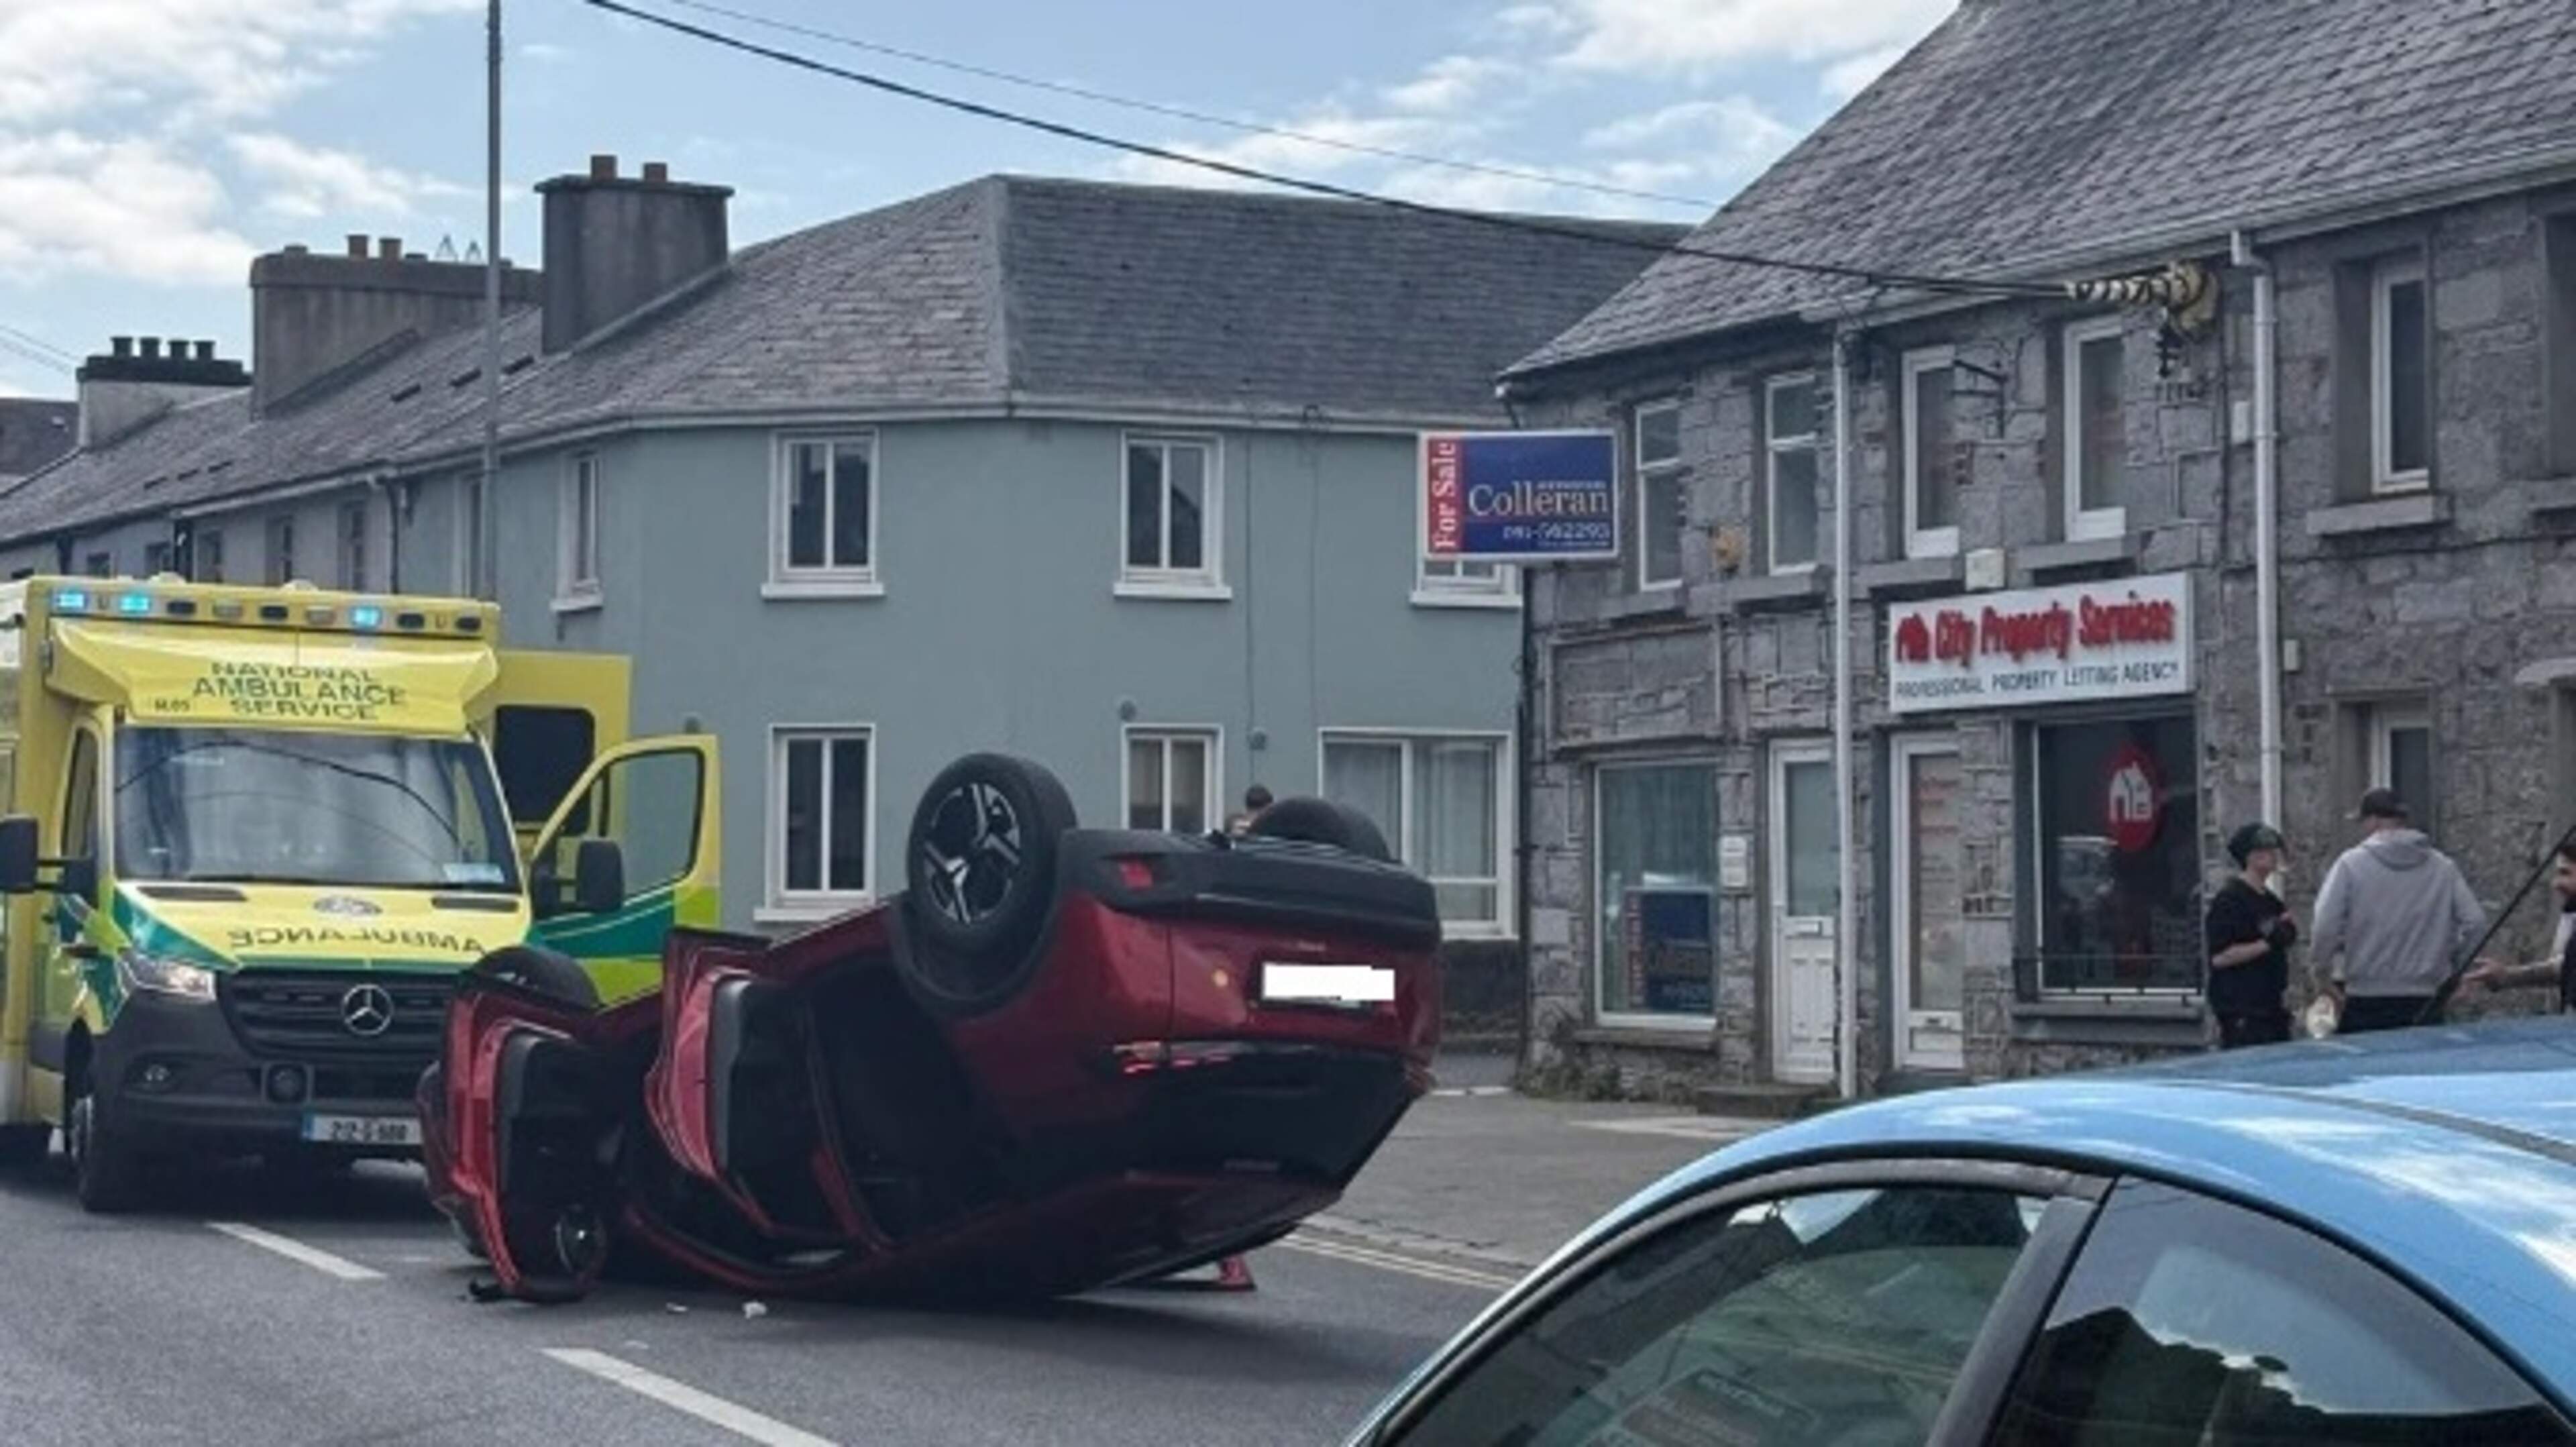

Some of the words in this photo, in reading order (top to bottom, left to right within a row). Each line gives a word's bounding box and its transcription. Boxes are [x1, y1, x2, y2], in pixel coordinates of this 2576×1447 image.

[1432, 442, 1456, 497] Sale
[1468, 480, 1608, 517] Colleran
[1433, 502, 1456, 548] For
[1935, 608, 1977, 669] City
[1980, 600, 2072, 663] Property
[2079, 590, 2175, 647] Services
[211, 661, 381, 683] NATIONAL
[1896, 676, 1984, 698] PROFESSIONAL
[1992, 669, 2056, 692] PROPERTY
[2064, 665, 2118, 686] LETTING
[2123, 660, 2178, 683] AGENCY
[192, 676, 408, 706] AMBULANCE
[229, 699, 379, 720] SERVICE
